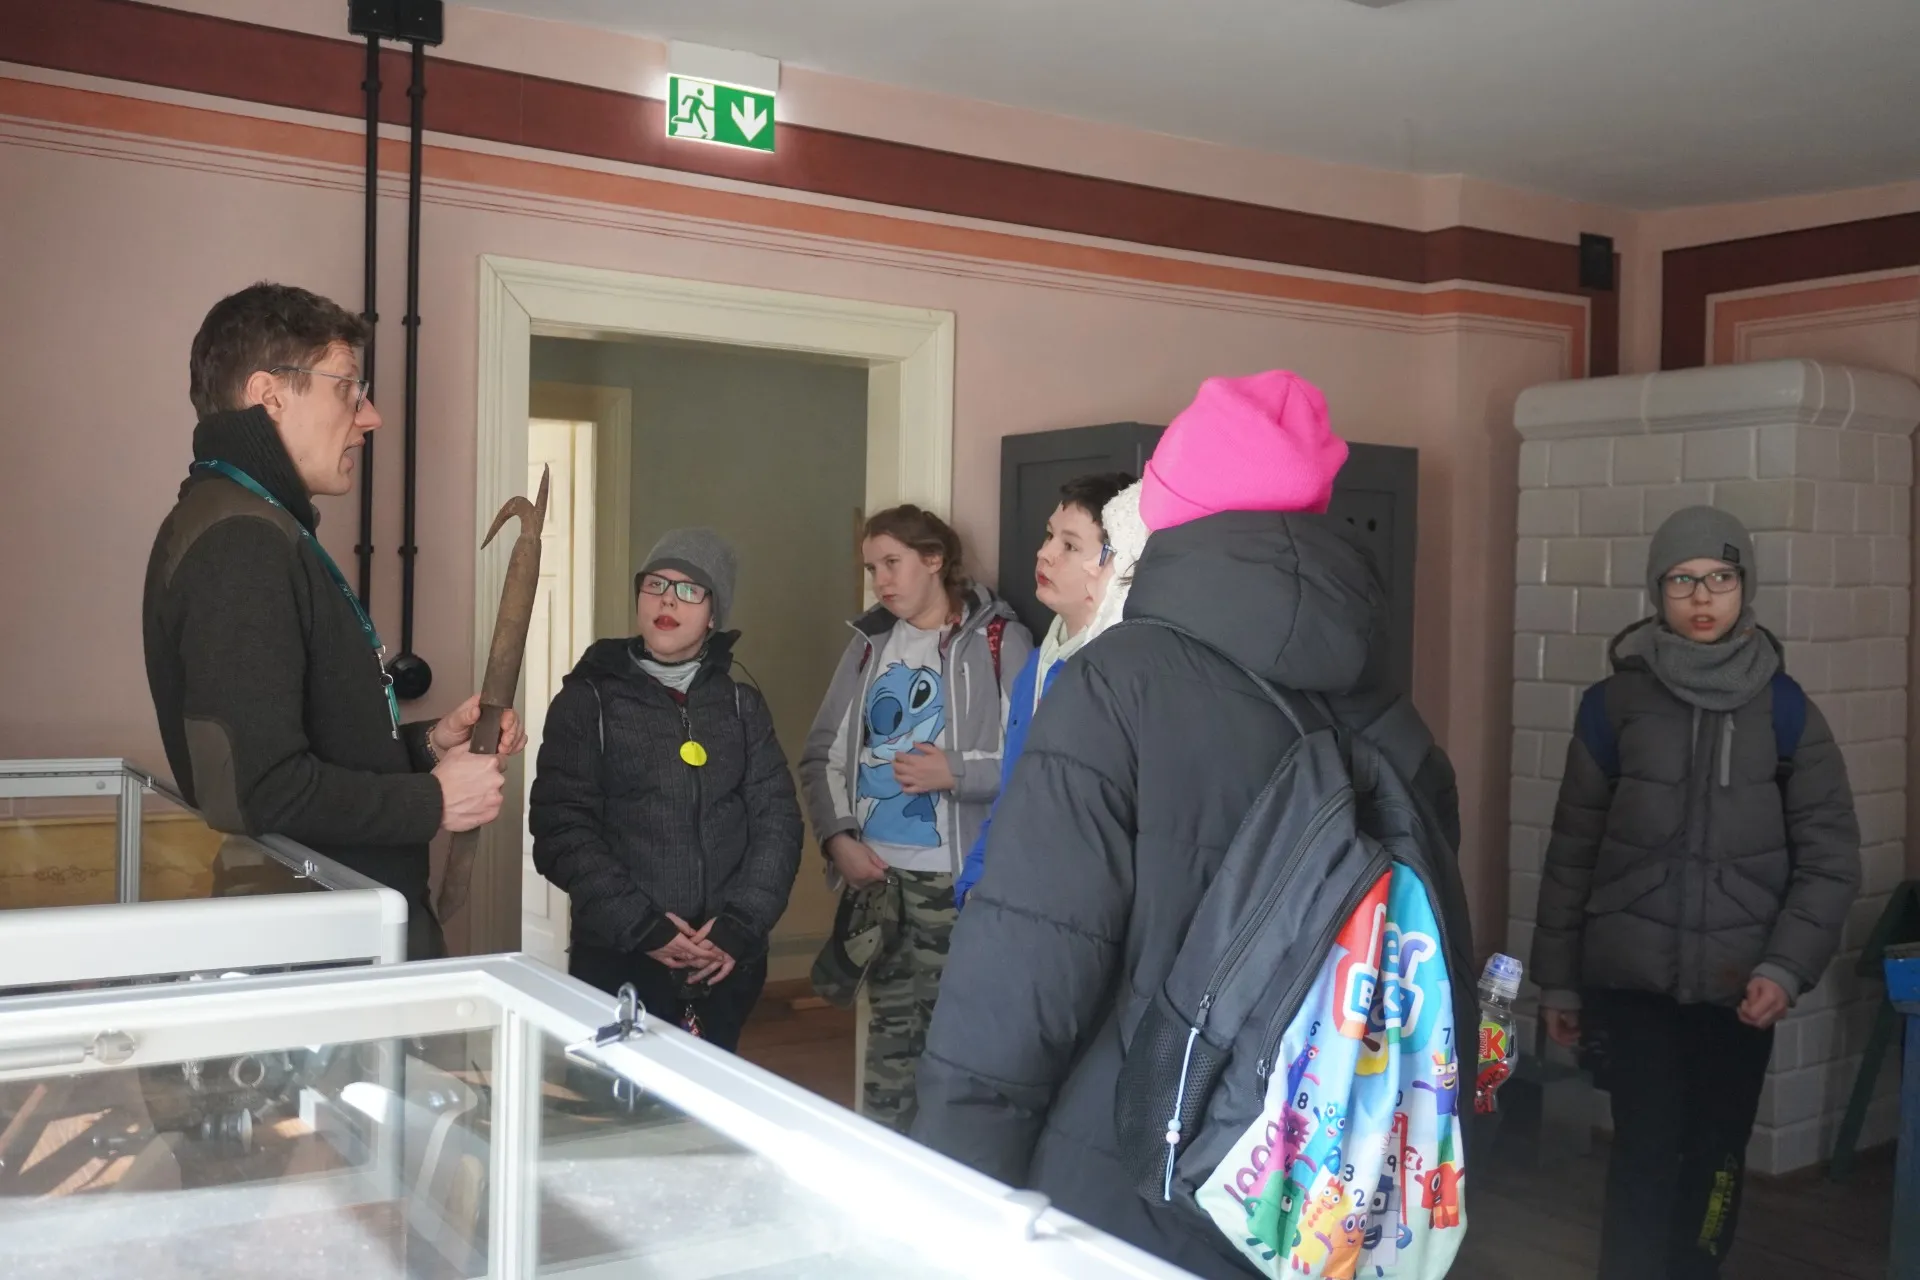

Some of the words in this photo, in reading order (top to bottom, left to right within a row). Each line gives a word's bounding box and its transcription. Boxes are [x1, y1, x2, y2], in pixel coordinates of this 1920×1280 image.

[1309, 1020, 1321, 1036] 6
[1443, 1027, 1451, 1045] 7
[1482, 1027, 1506, 1061] K
[1297, 1092, 1308, 1110] 8
[1387, 1154, 1397, 1173] 9
[1343, 1164, 1355, 1182] 3
[1353, 1189, 1365, 1207] 2
